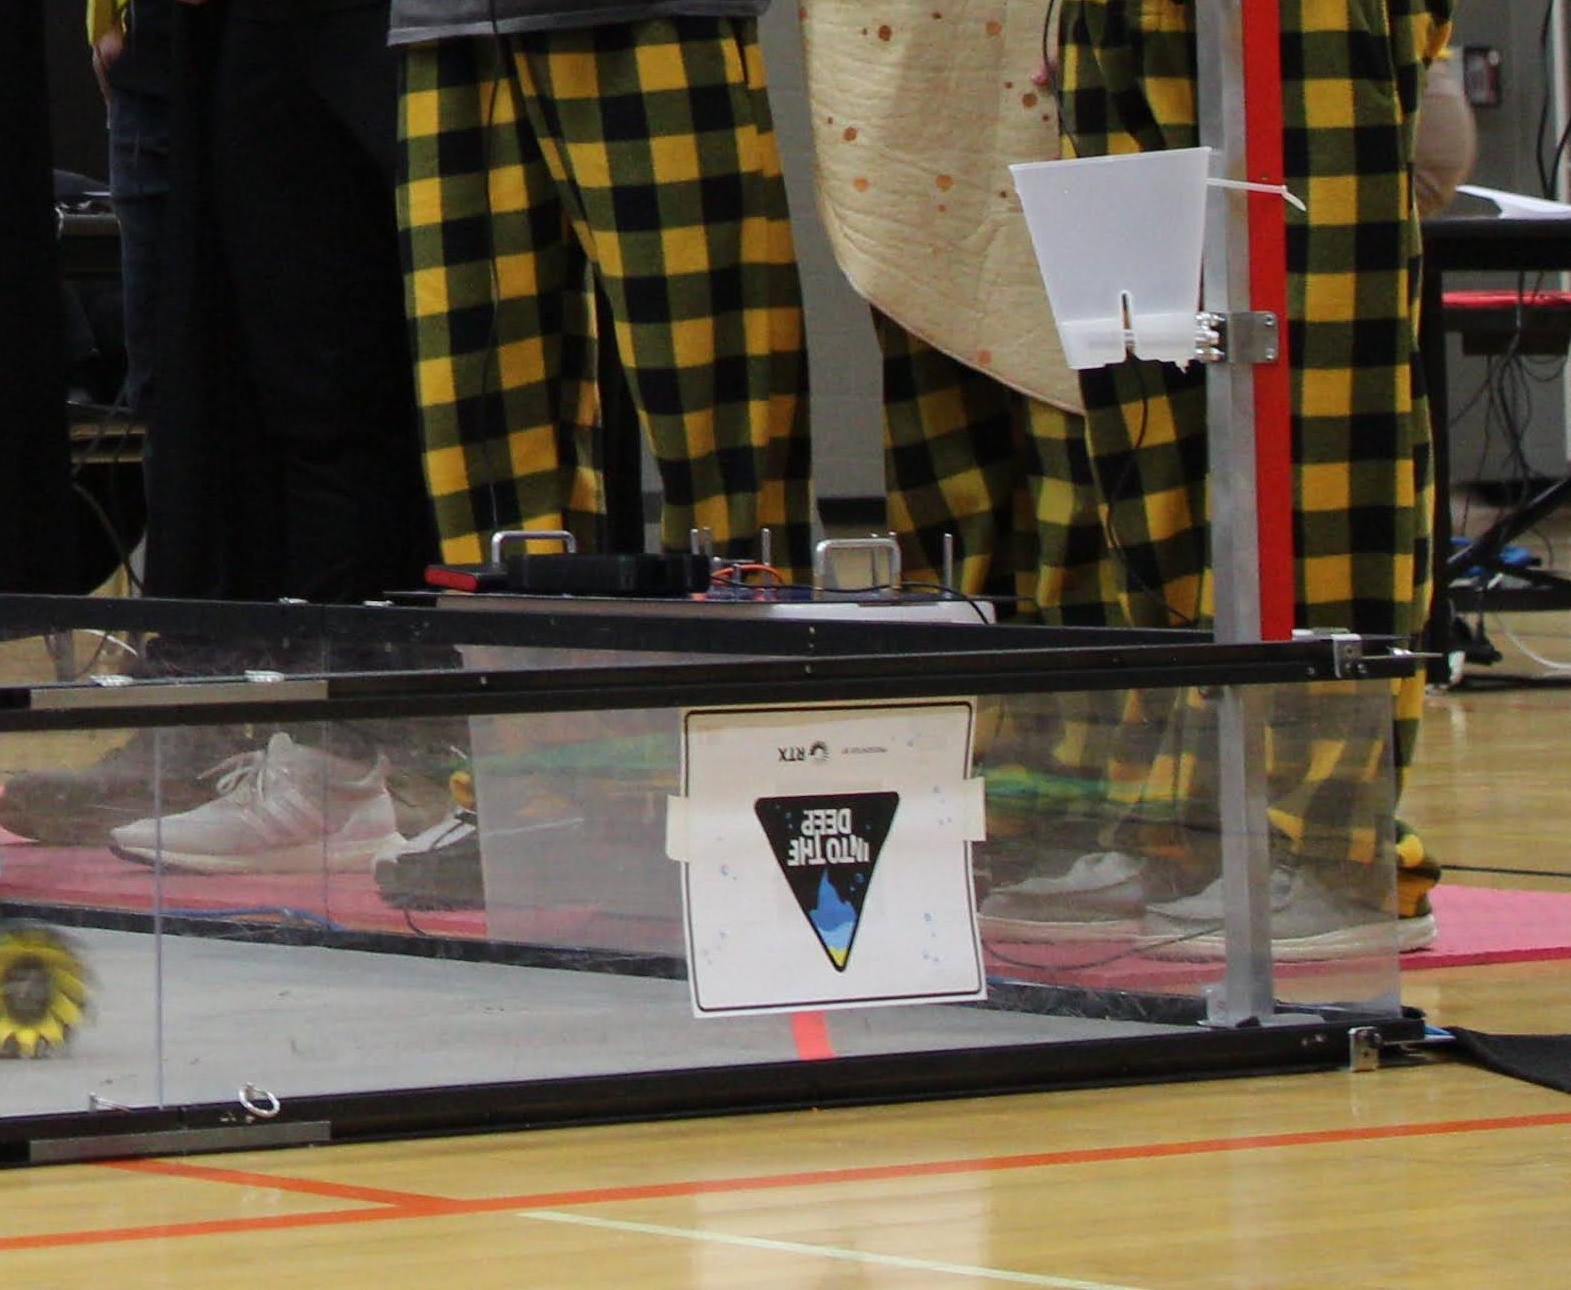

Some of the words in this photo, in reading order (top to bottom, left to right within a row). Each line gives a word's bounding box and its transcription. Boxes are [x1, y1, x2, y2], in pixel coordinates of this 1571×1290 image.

[777, 746, 805, 762] RTX
[801, 807, 852, 837] DEEP
[787, 831, 827, 866] THE
[826, 834, 869, 864] INTO
